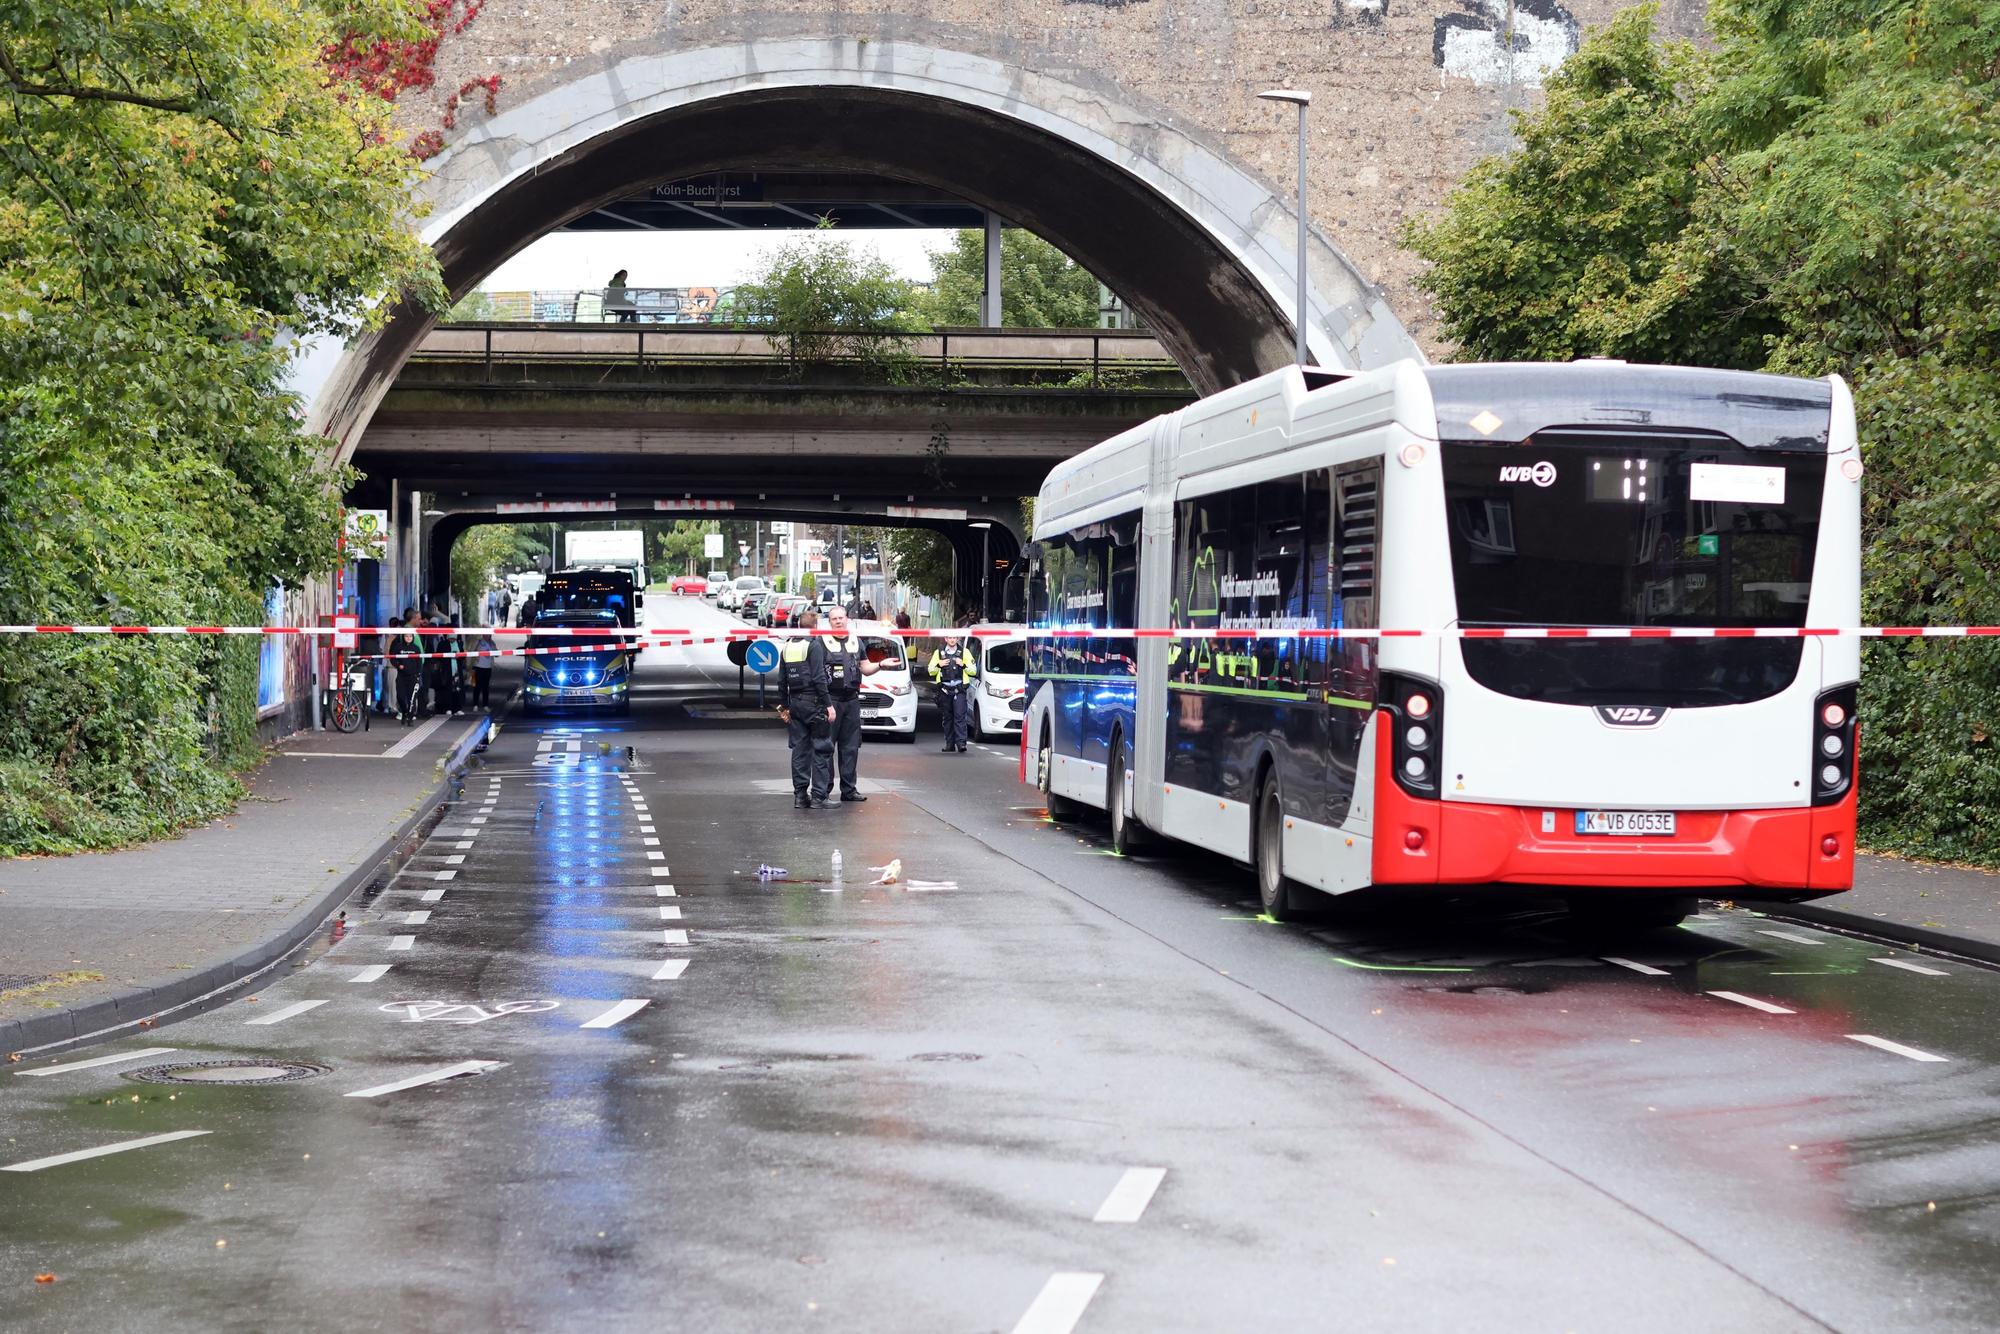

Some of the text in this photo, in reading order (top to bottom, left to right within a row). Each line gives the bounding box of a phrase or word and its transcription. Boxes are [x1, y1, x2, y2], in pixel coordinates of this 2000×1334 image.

[1500, 466, 1532, 482] KVB
[1604, 707, 1657, 722] VDL
[1587, 814, 1672, 831] K VB 6053E
